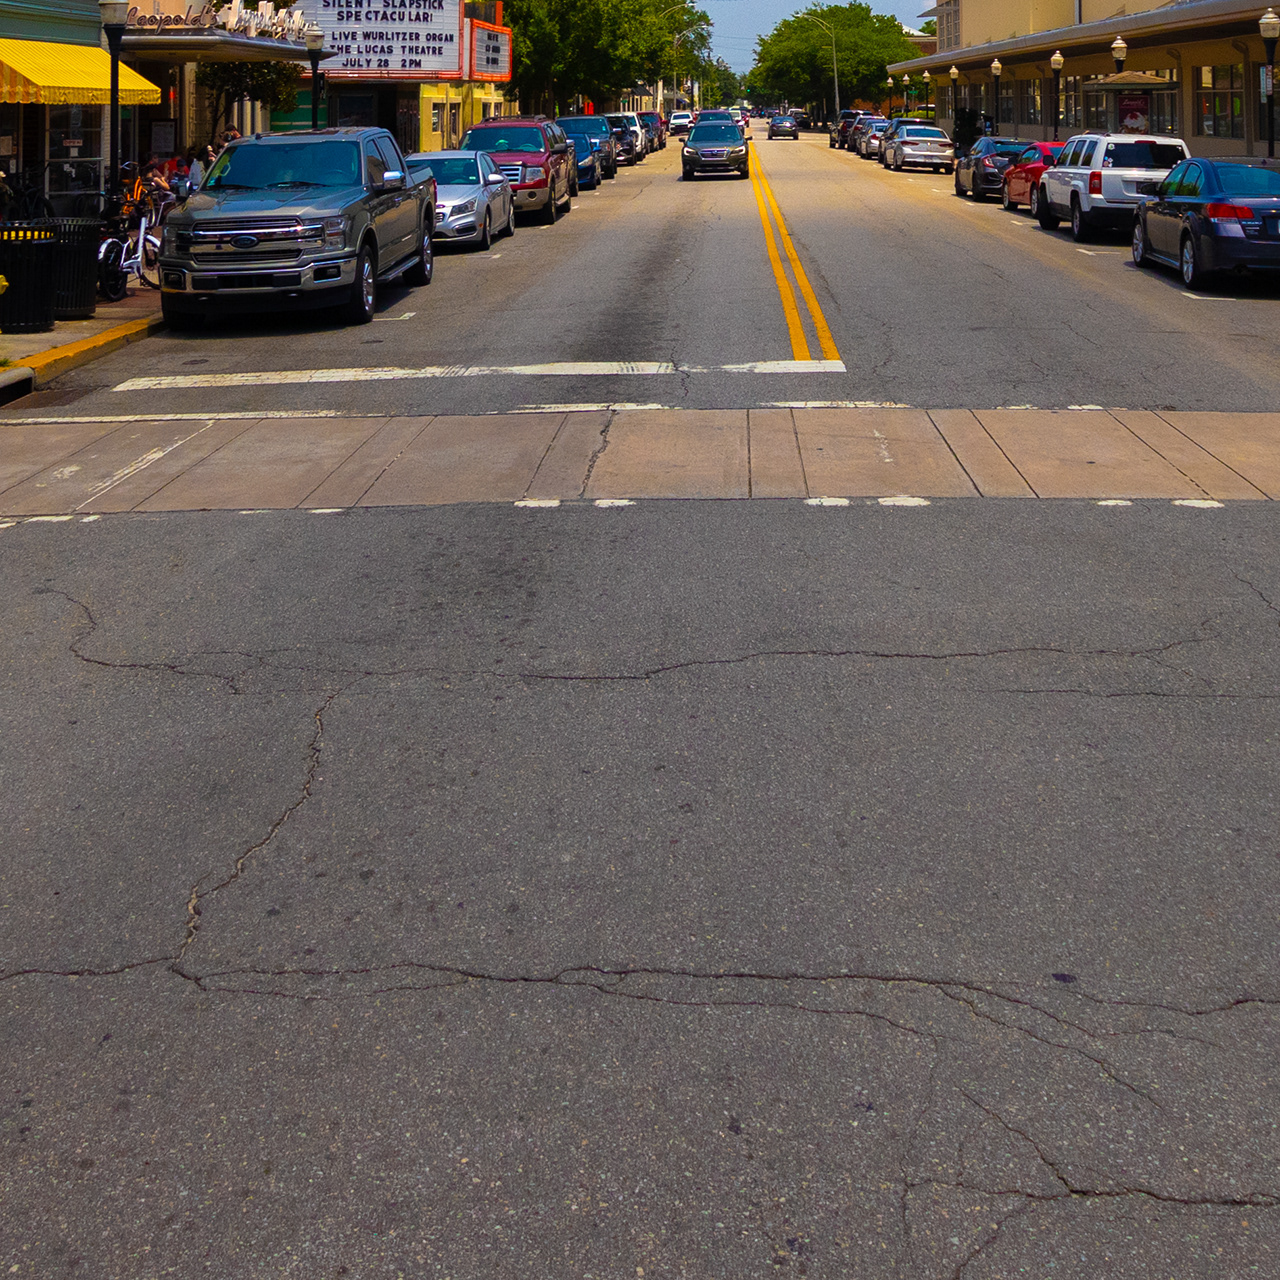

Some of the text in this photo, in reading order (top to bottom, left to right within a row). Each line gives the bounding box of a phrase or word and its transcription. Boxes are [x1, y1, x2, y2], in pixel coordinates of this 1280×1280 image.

[332, 31, 454, 43] LIVE WURLITZER ORGAN
[330, 45, 443, 55] THE LUCAS THEATRE
[342, 58, 373, 68] JULY
[377, 58, 390, 68] 28
